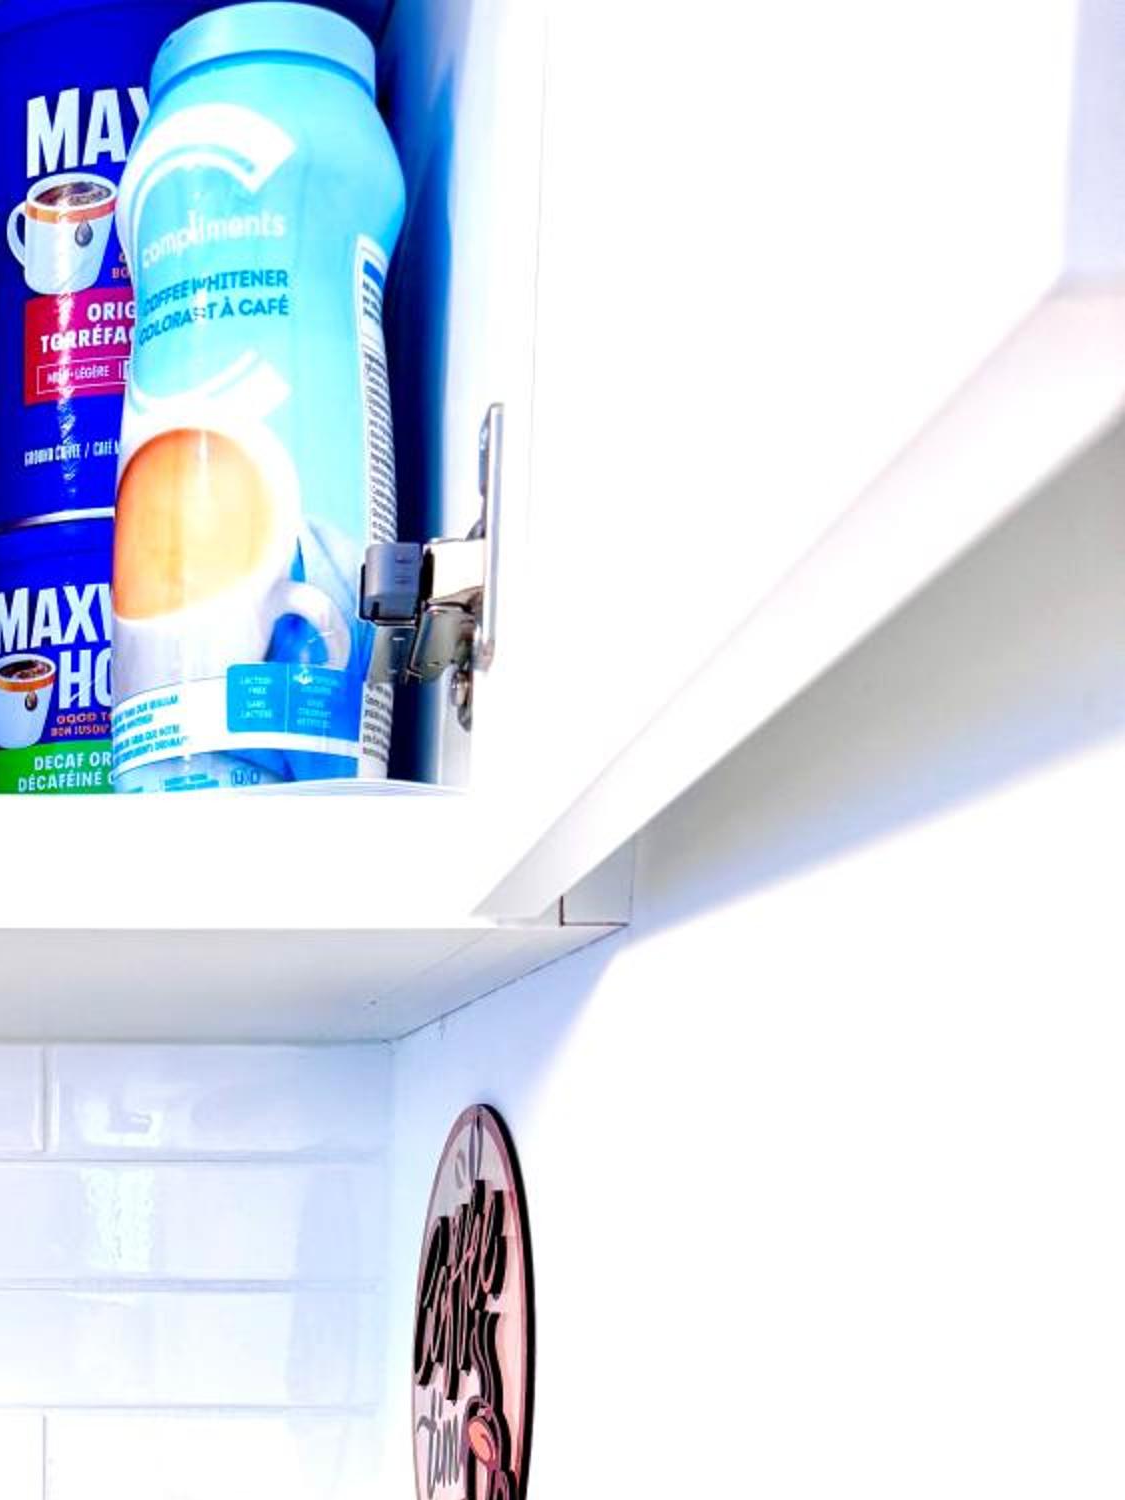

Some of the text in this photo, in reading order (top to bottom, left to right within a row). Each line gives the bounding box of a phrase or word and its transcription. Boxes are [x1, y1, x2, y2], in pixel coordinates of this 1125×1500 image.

[142, 209, 285, 269] compliments
[143, 269, 288, 318] COFFEE WHITENER
[139, 294, 290, 346] COLORAT À CAFÉ
[57, 711, 97, 724] GOOD
[18, 767, 102, 793] DÉCAFÉINÉ
[34, 752, 84, 771] DECAF
